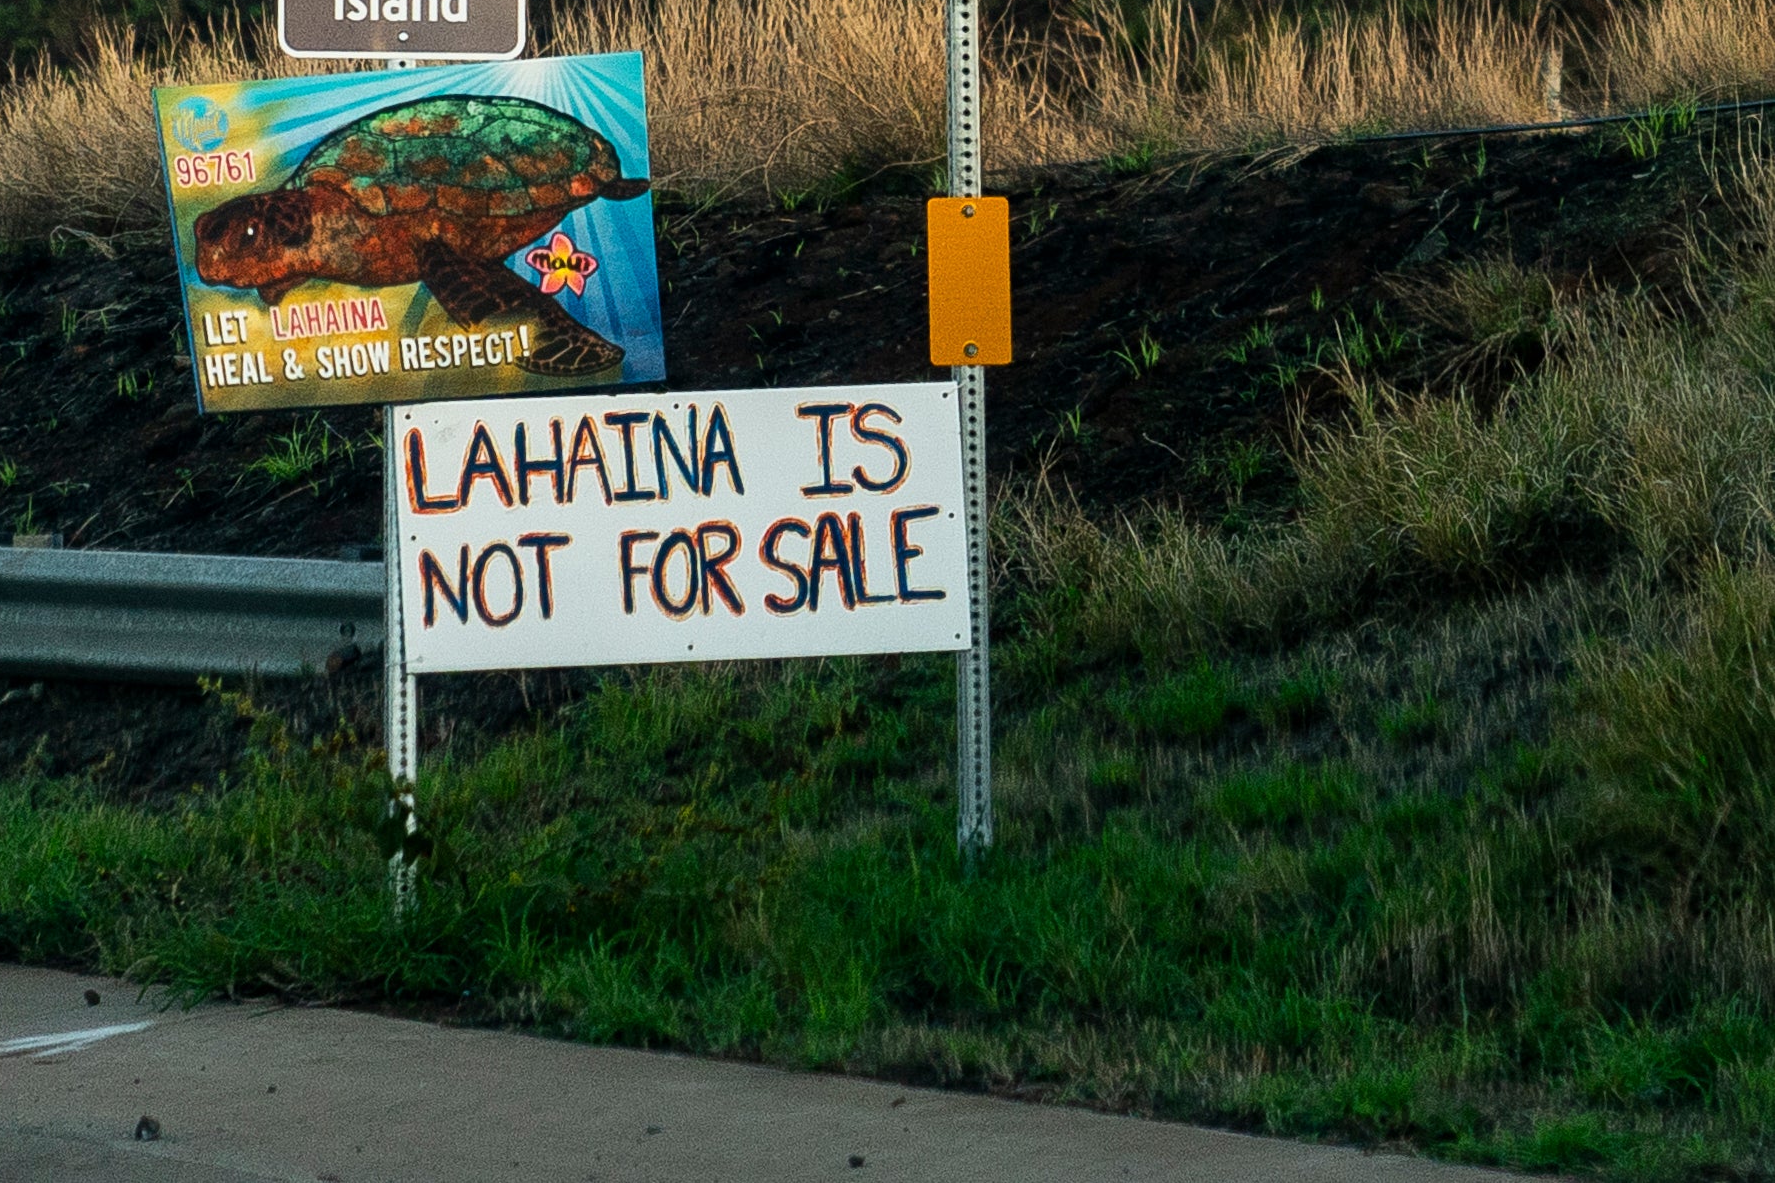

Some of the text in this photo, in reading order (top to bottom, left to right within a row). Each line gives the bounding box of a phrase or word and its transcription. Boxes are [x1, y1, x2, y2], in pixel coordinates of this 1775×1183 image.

[175, 150, 255, 187] 96761
[204, 298, 387, 345] LET LAHAINA
[206, 325, 530, 386] HEAL & SHOW RESPECT!
[405, 401, 912, 514] LAHAINA IS
[419, 505, 947, 629] NOT FOR SALE
